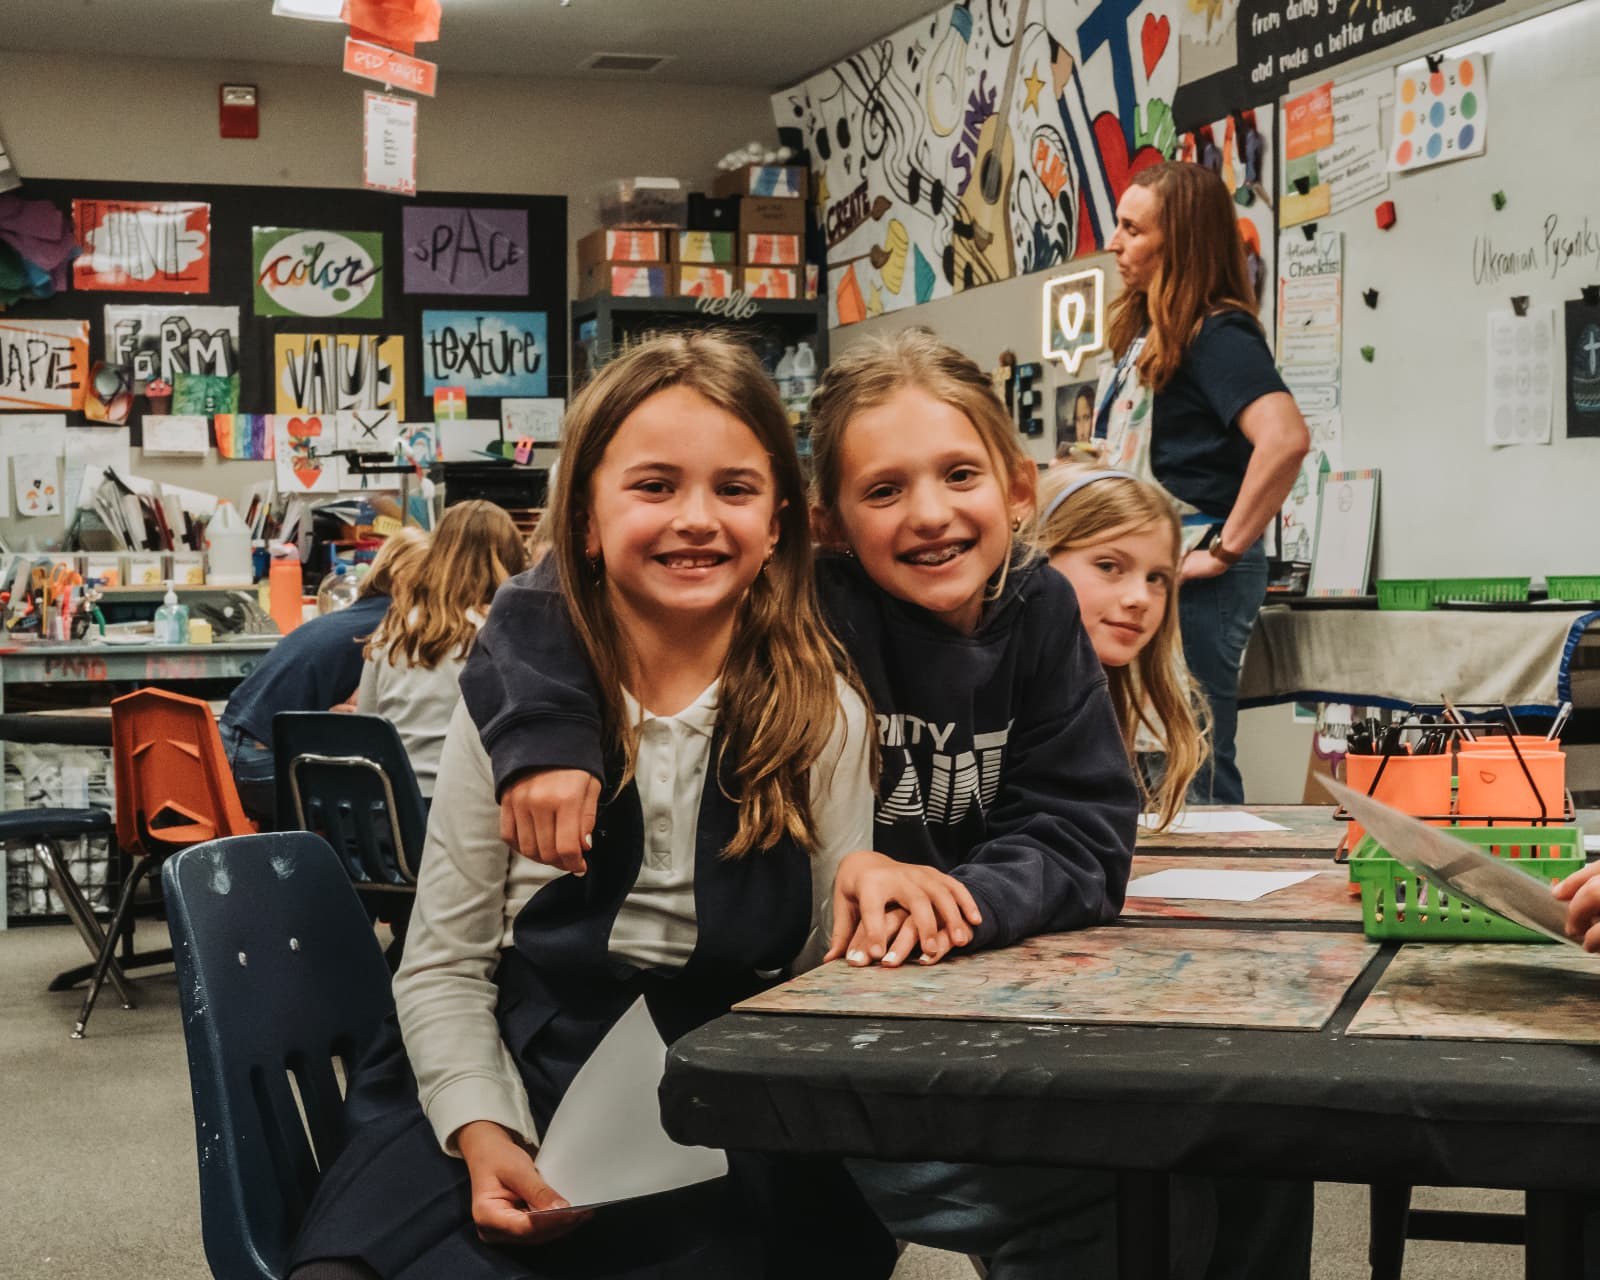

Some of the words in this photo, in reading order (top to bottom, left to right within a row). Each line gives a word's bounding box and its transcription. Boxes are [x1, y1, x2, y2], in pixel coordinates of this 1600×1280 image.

[1252, 12, 1280, 37] from
[1252, 55, 1273, 83] and
[1280, 45, 1309, 73] make
[1314, 41, 1324, 57] a
[1328, 22, 1365, 52] better
[1372, 6, 1417, 36] choice.
[826, 180, 872, 244] CREATE
[694, 289, 760, 319] hello
[0, 336, 81, 392] APE
